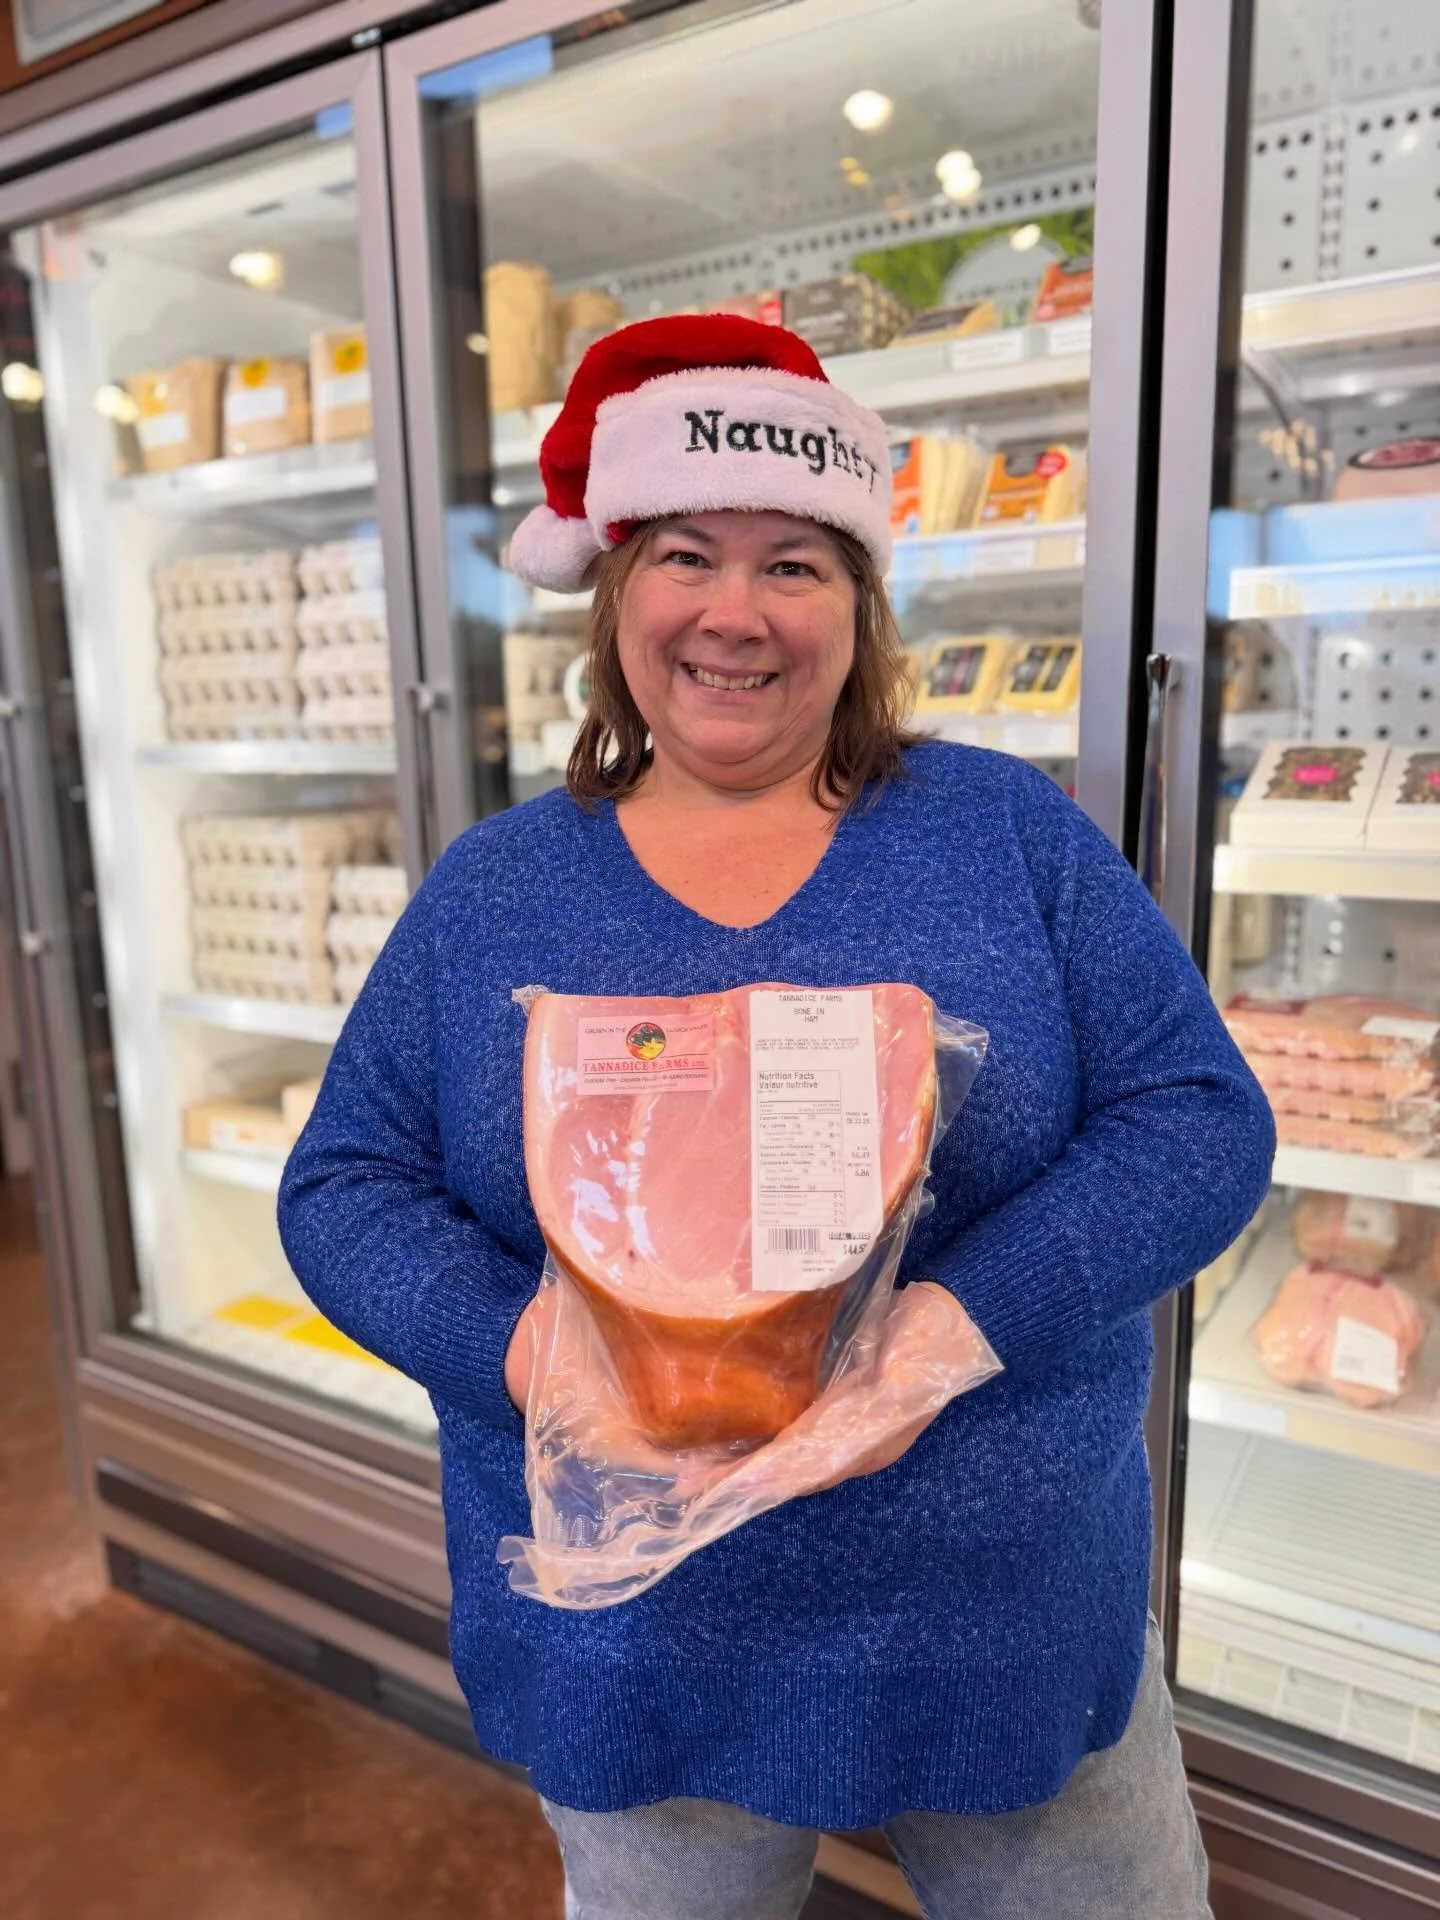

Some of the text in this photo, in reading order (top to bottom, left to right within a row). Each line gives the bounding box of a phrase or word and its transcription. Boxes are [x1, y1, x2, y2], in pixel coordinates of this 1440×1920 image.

[684, 409, 879, 493] Naughty
[820, 994, 843, 1002] FARMS
[793, 1007, 825, 1016] BONE IN
[804, 1015, 818, 1023] HAM
[582, 1061, 649, 1073] TANNADICE
[759, 1071, 815, 1080] Nutrition Facts
[759, 1081, 818, 1089] Valeur nutritive
